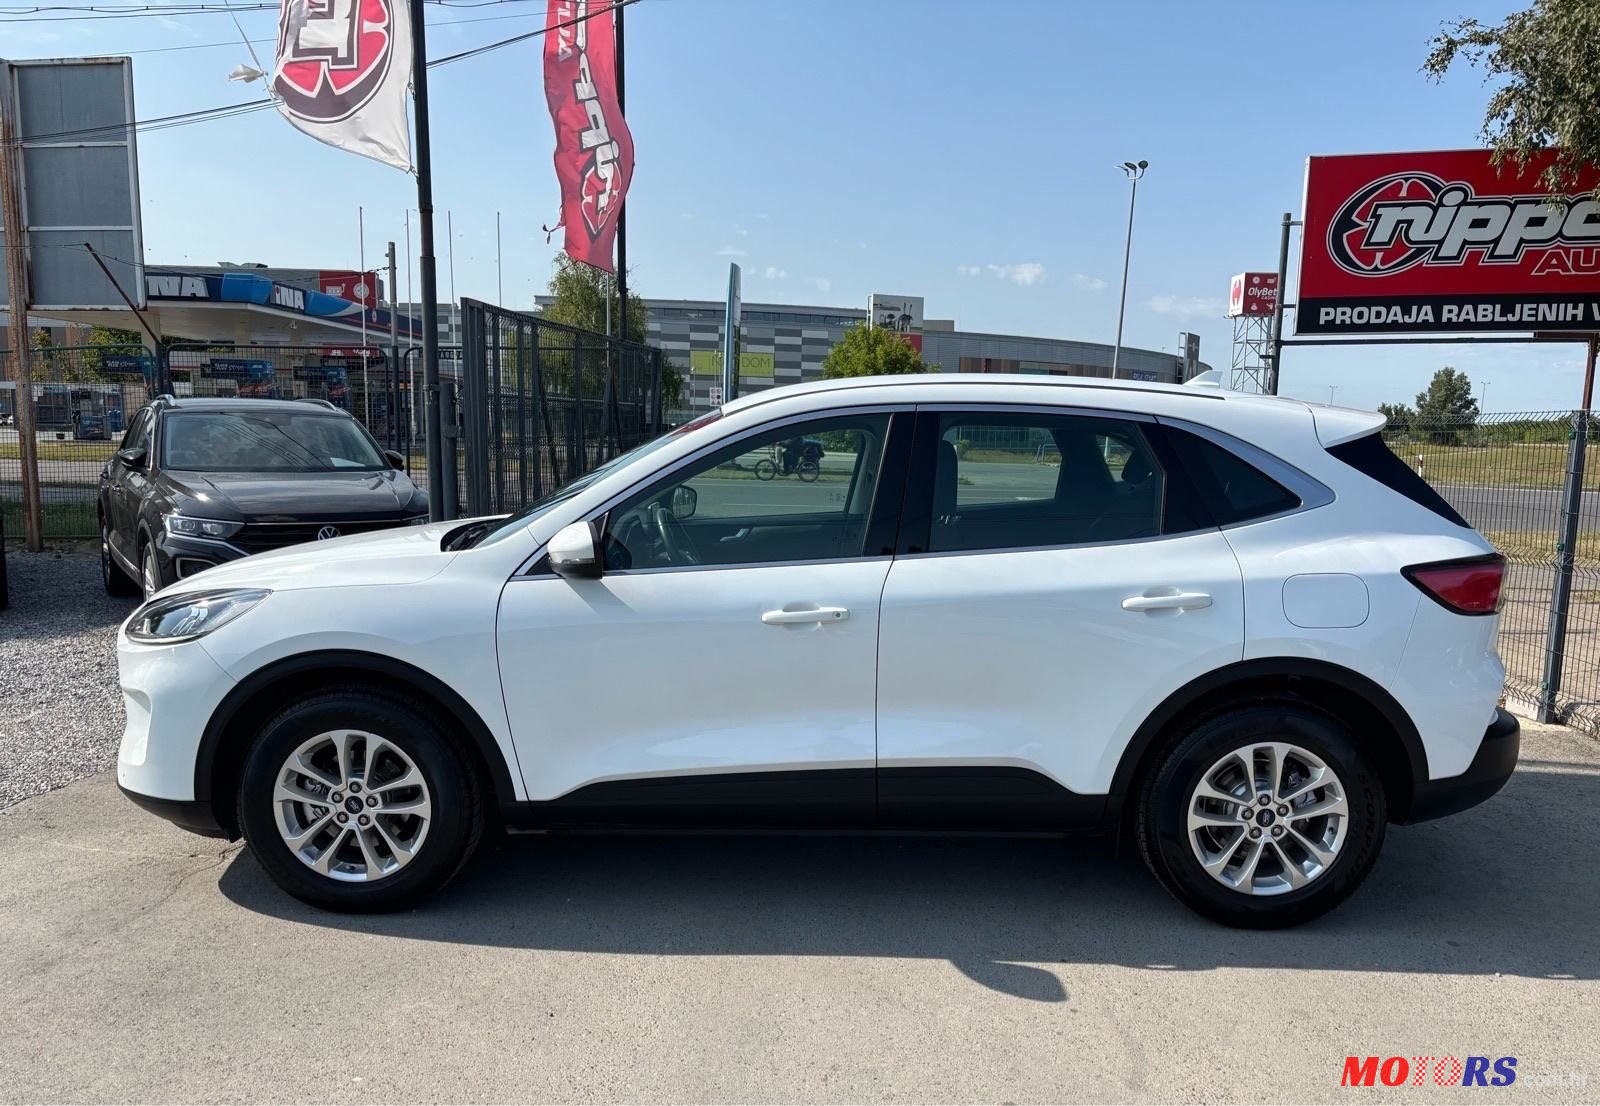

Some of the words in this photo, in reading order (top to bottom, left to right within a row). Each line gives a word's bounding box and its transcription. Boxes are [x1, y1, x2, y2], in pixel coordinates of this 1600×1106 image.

[1248, 287, 1277, 298] OlyBet
[1319, 305, 1435, 325] PRODAJA
[1441, 303, 1584, 323] RABLJENIH
